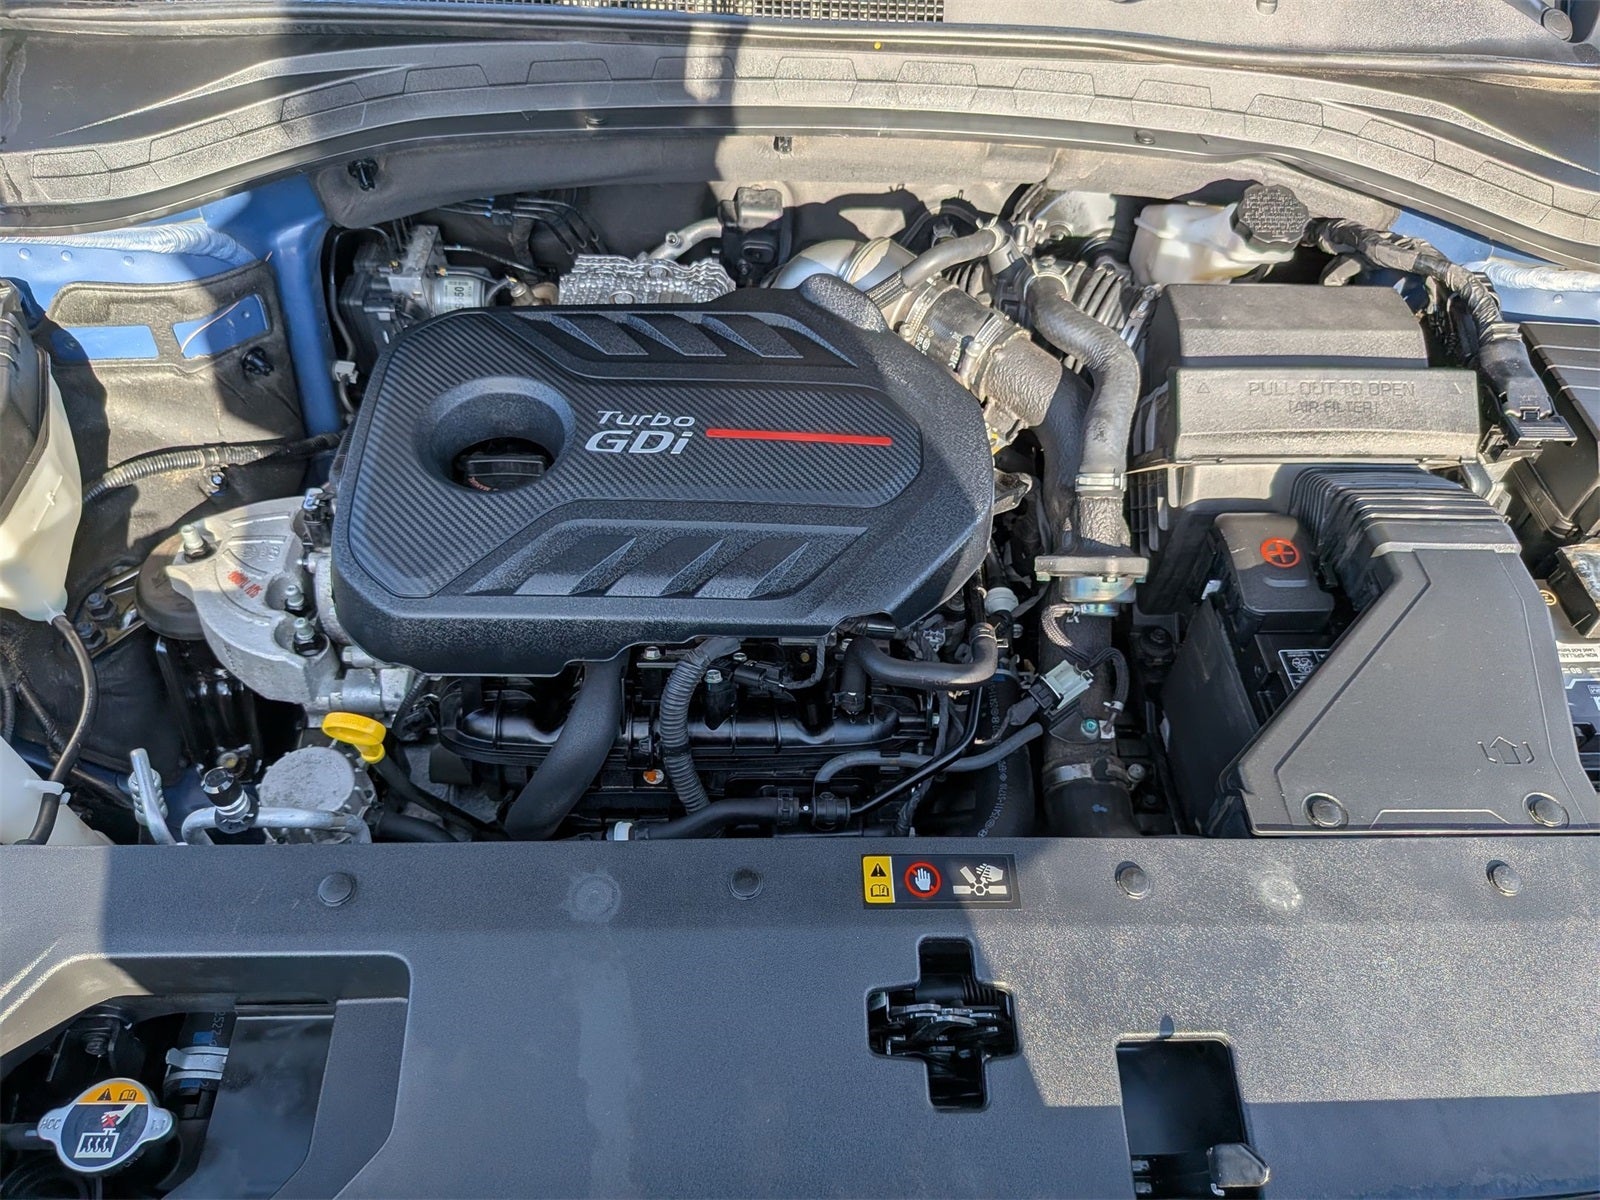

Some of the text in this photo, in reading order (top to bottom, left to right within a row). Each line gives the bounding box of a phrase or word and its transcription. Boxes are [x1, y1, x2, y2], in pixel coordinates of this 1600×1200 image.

[1248, 380, 1415, 397] PULL OUT TO OPEN
[597, 410, 696, 427] Turbo
[584, 429, 694, 455] GDi
